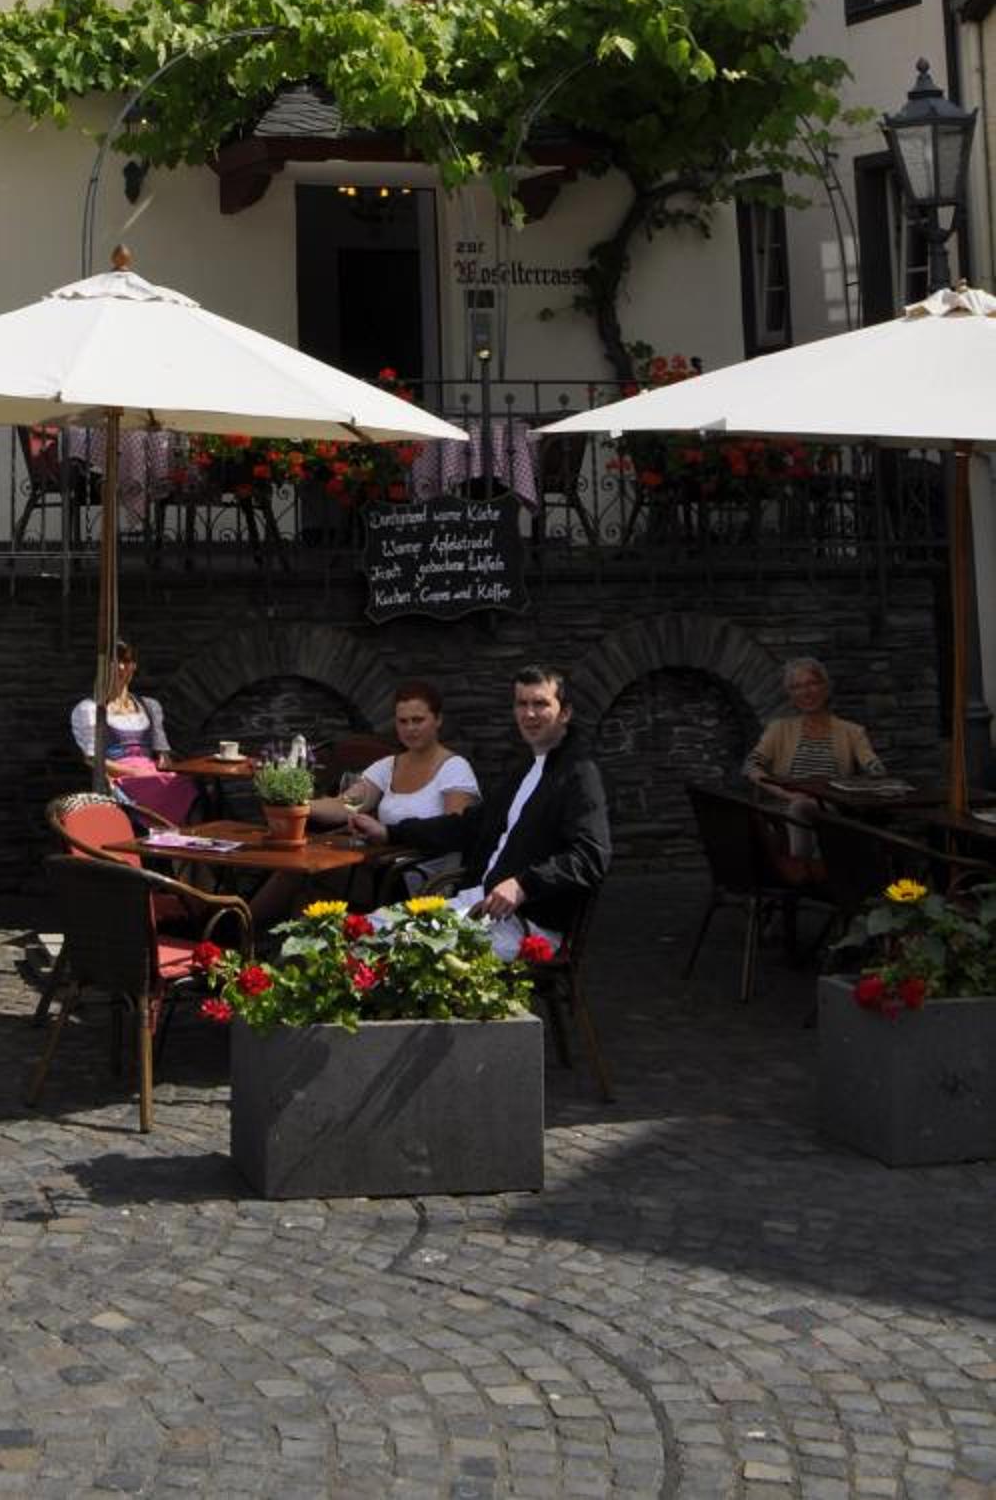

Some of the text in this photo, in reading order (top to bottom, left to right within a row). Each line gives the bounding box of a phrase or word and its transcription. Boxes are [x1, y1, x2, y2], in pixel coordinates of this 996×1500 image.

[455, 241, 484, 254] zur
[430, 529, 493, 558] Apfelstrudel
[452, 584, 472, 599] und
